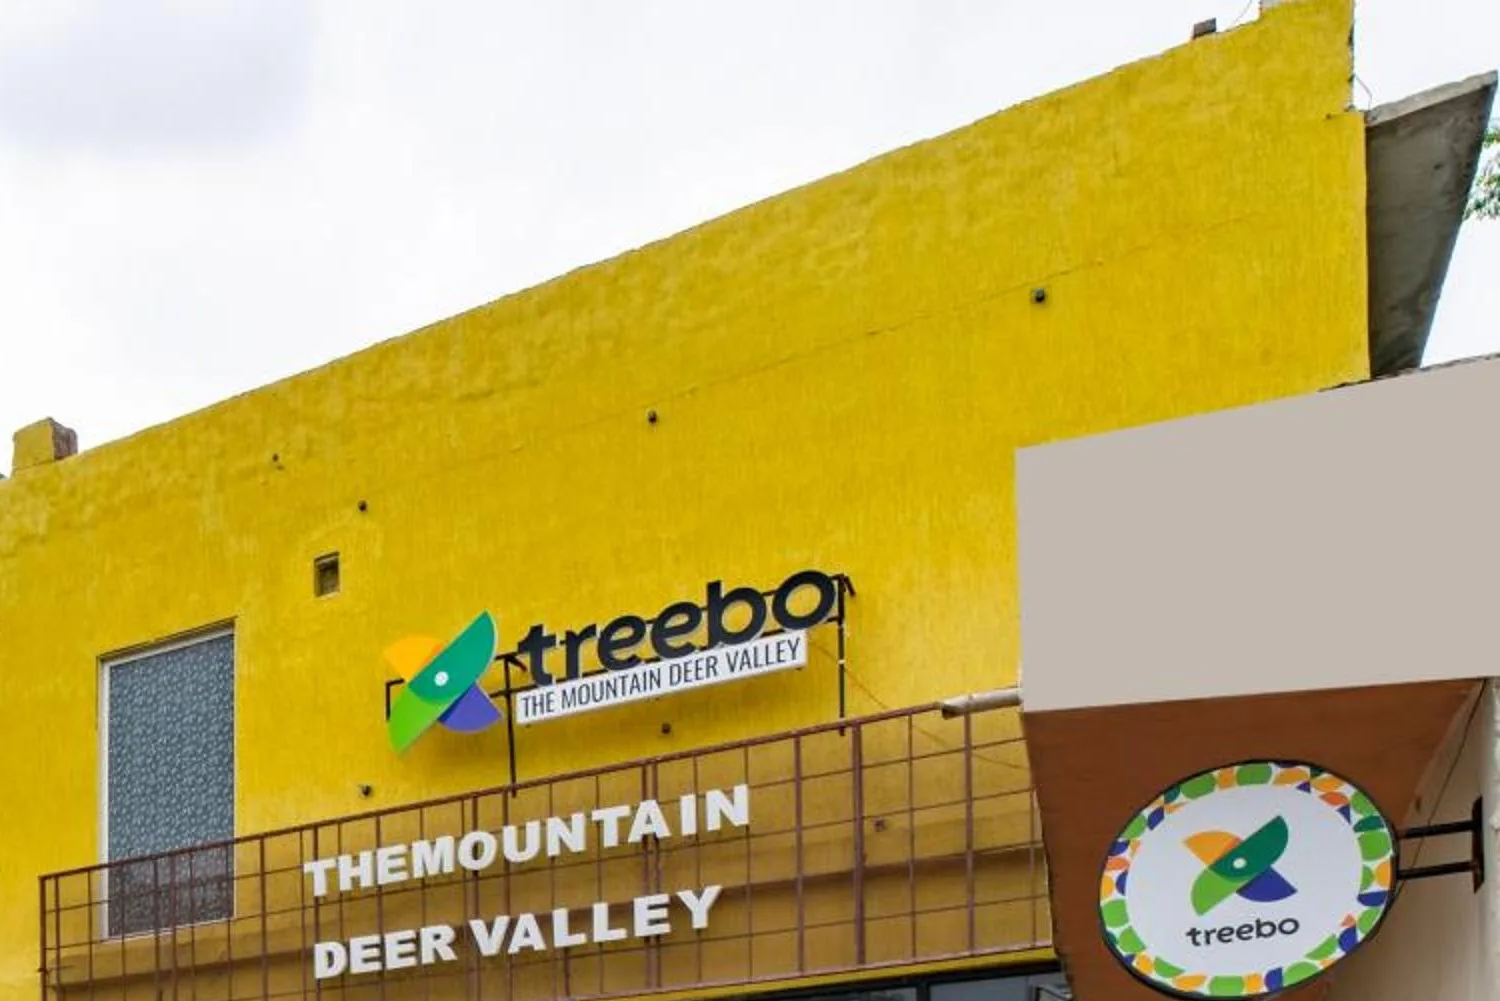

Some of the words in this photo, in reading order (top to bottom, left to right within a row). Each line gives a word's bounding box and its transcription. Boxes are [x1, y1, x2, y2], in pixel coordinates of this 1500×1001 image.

[517, 569, 836, 686] treebo
[522, 691, 556, 718] THE
[561, 667, 662, 710] MOUNTAIN
[669, 654, 719, 686] DEER
[726, 637, 801, 673] VALLEY
[313, 923, 457, 980] DEER
[468, 884, 723, 958] VALLEY
[1185, 916, 1300, 947] treebo
